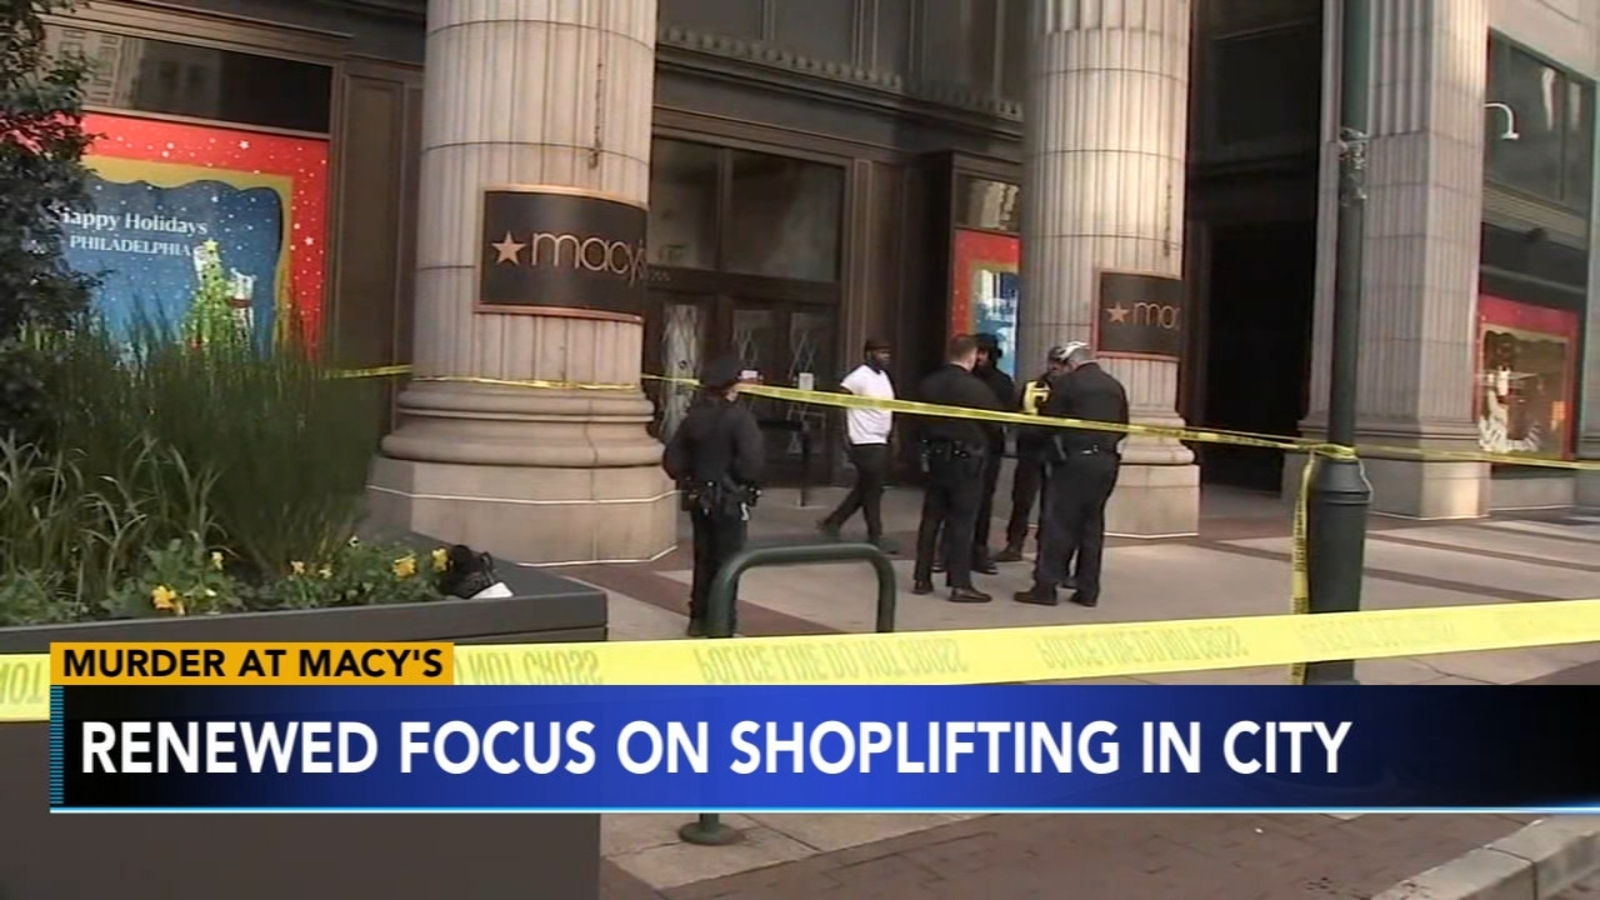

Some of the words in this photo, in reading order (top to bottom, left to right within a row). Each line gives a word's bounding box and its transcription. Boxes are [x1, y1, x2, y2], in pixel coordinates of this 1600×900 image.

[125, 212, 208, 235] Holidays
[69, 234, 192, 257] PHILADELPHIA
[1132, 301, 1181, 331] ma
